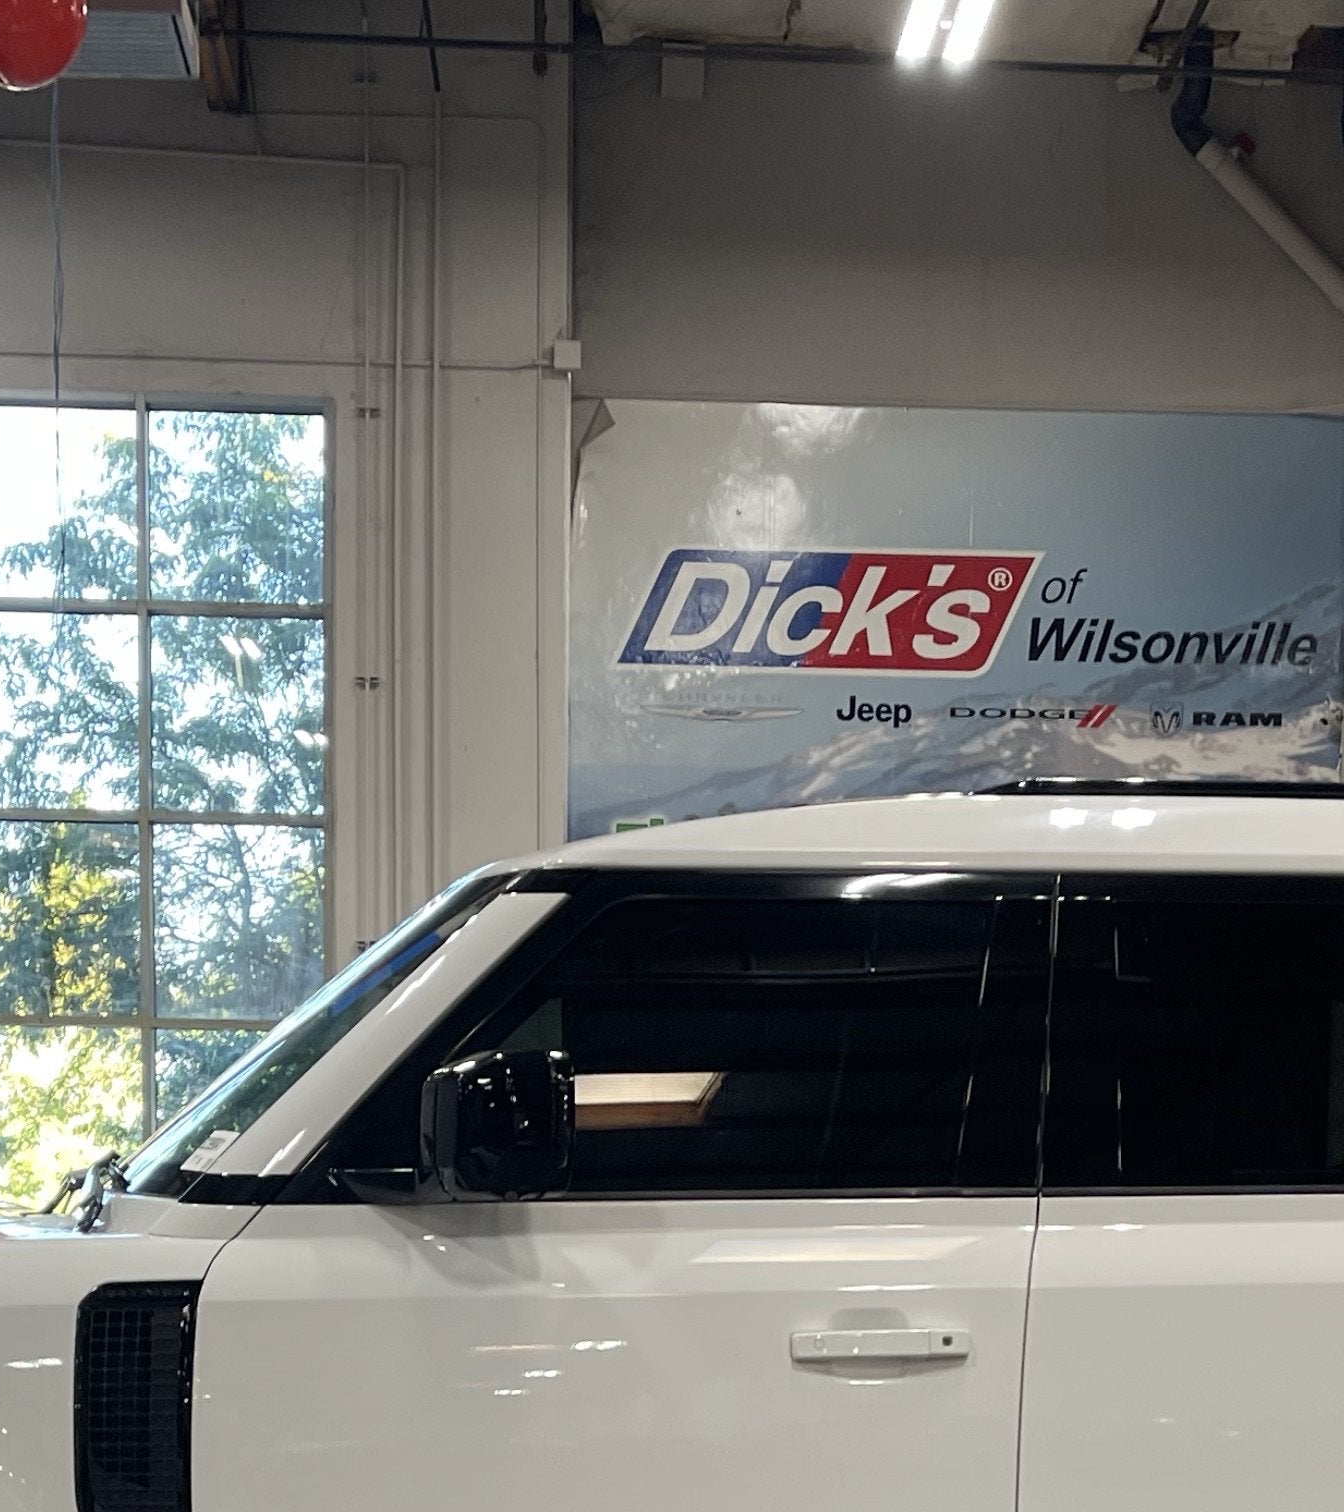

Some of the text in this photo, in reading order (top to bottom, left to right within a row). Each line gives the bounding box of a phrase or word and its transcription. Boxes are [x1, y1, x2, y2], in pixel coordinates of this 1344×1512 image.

[1040, 567, 1088, 605] of
[1026, 615, 1318, 667] Wilsonville
[836, 695, 913, 728] Jeep
[949, 706, 1092, 721] DODGE
[1192, 711, 1283, 727] RAM
